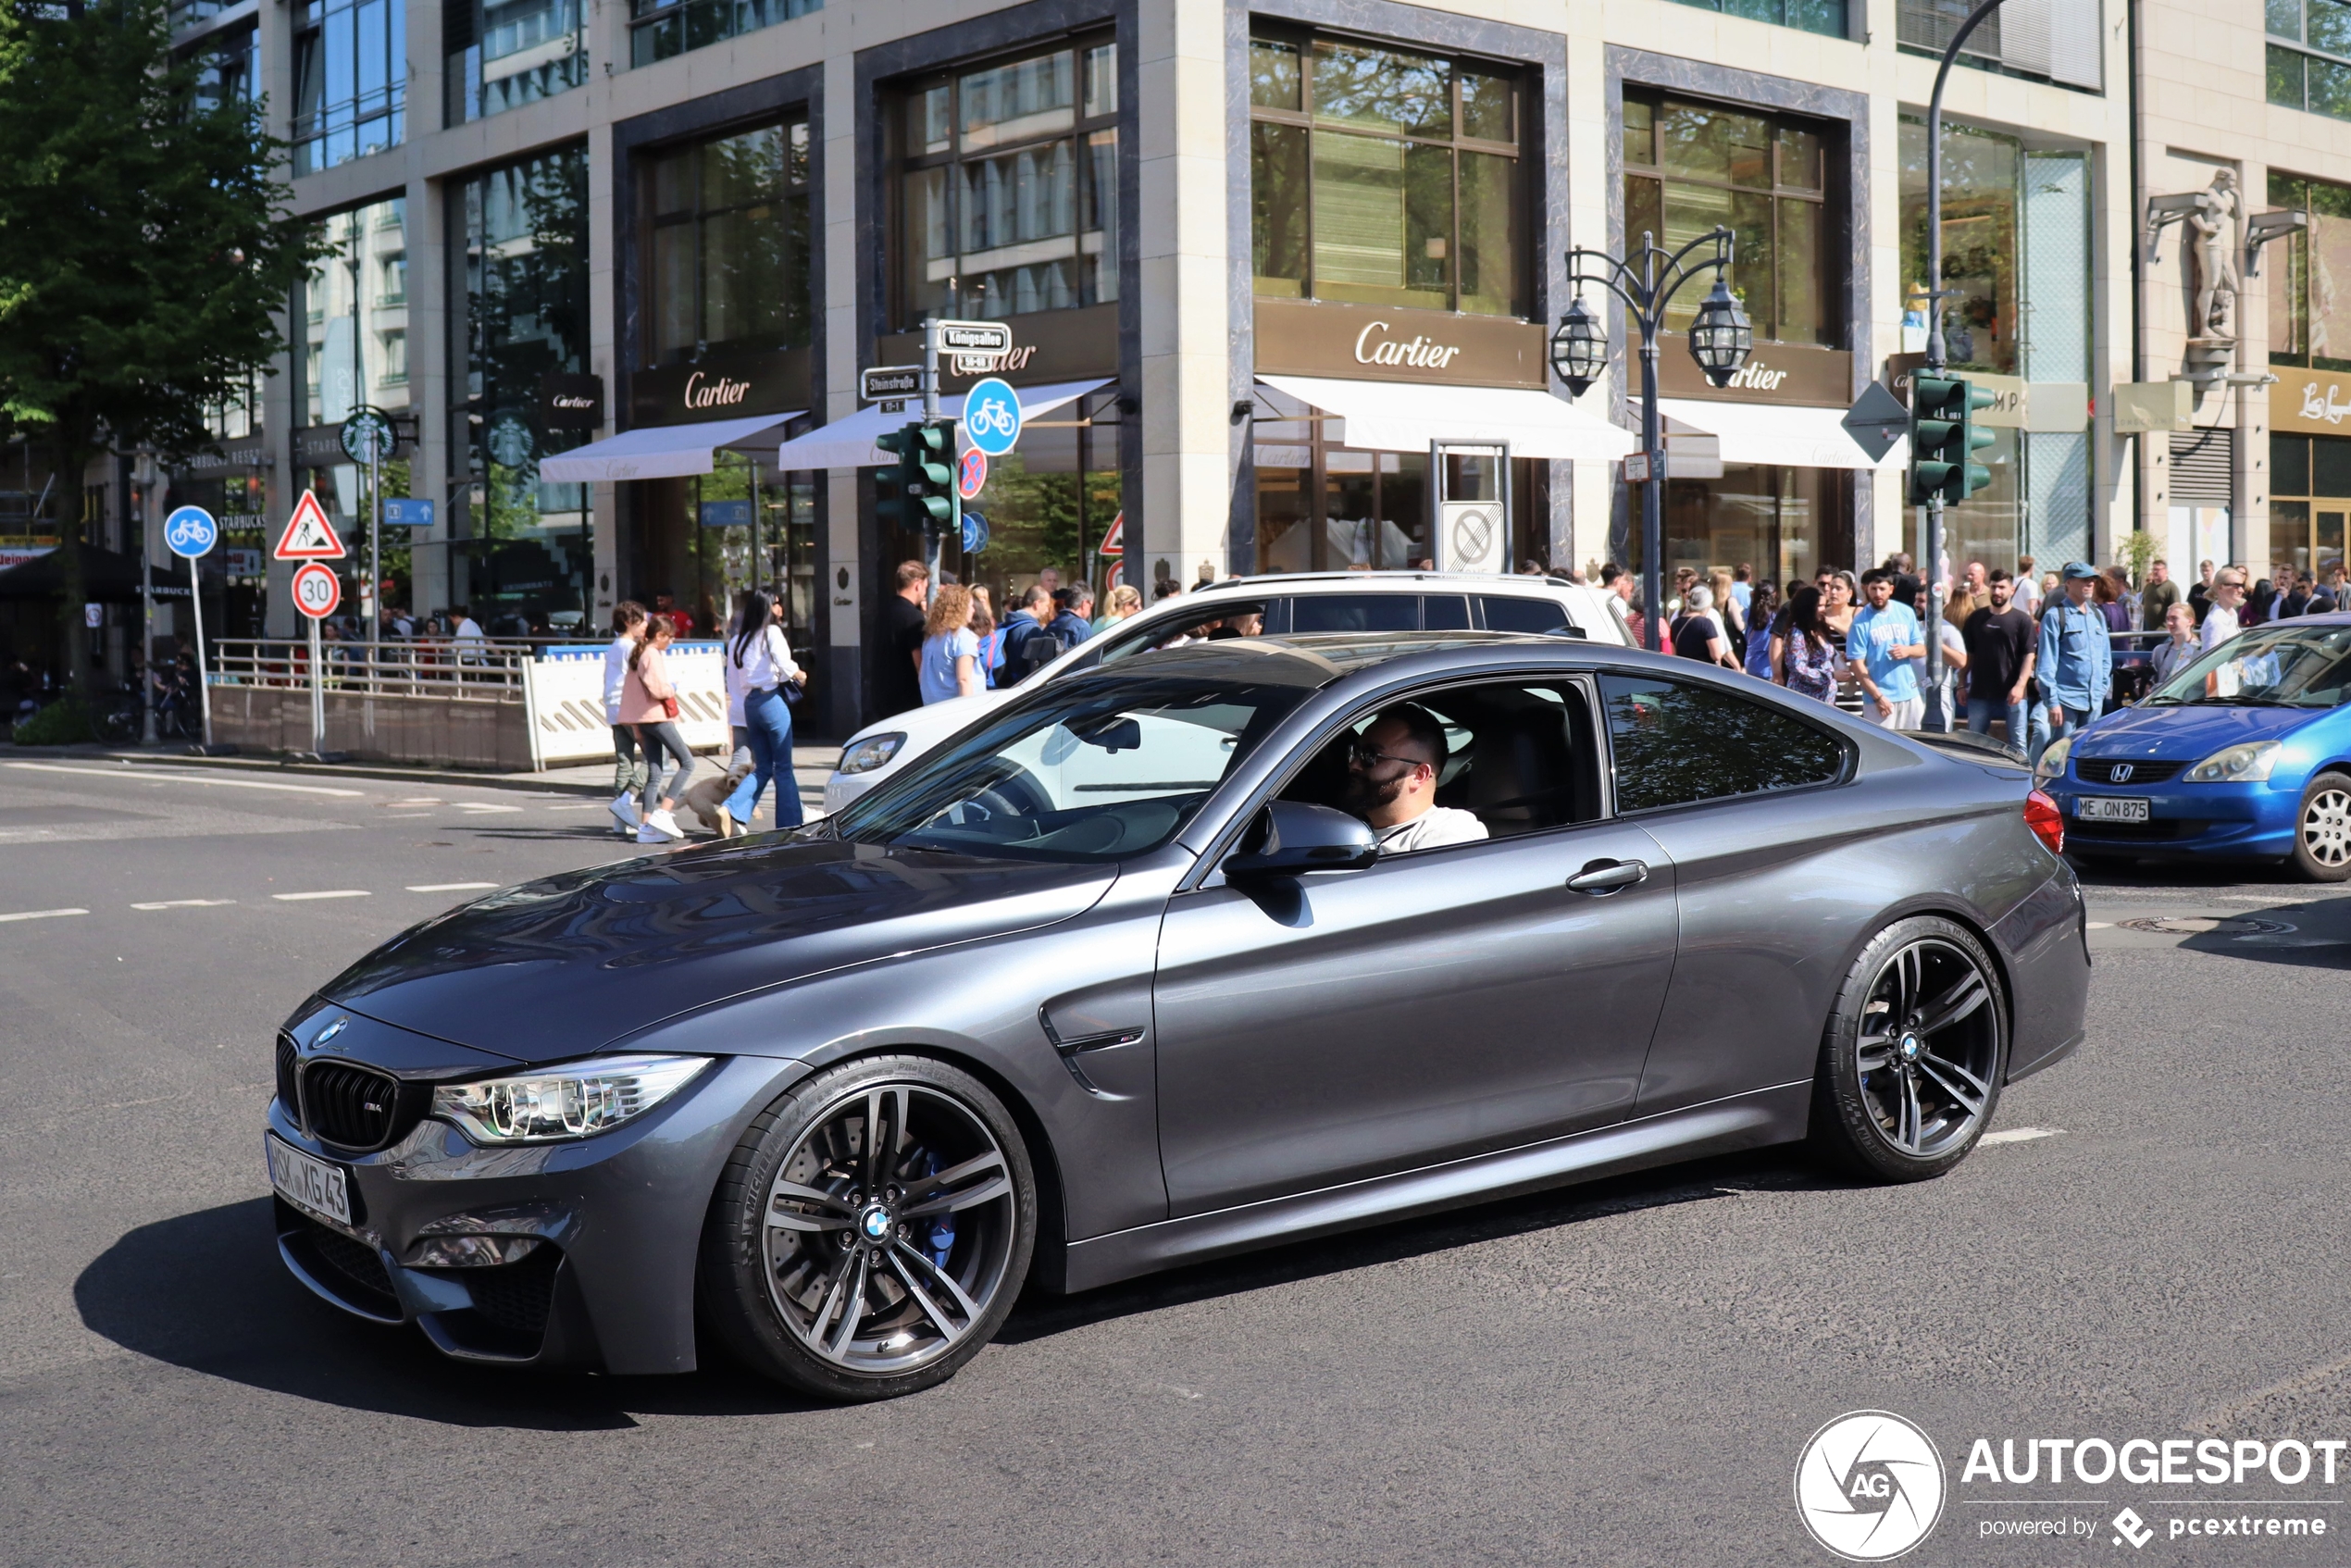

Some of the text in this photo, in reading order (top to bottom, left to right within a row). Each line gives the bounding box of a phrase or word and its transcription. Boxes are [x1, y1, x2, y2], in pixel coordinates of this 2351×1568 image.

[949, 330, 1001, 347] Königsallee
[1356, 321, 1460, 368] Cartier
[951, 345, 1037, 377] Cier
[685, 371, 751, 409] Cartier
[869, 375, 914, 391] Steinstraße
[553, 394, 594, 408] Cartier
[219, 514, 267, 530] STARBUCKS
[135, 585, 193, 595] SARBUCK
[304, 579, 329, 602] 30
[1870, 623, 1909, 646] ROUGH
[2079, 800, 2146, 818] ME ON 875
[1953, 927, 1993, 975] MICHELIN
[897, 1063, 923, 1073] Pilot
[273, 1150, 345, 1215] HSK XG 43
